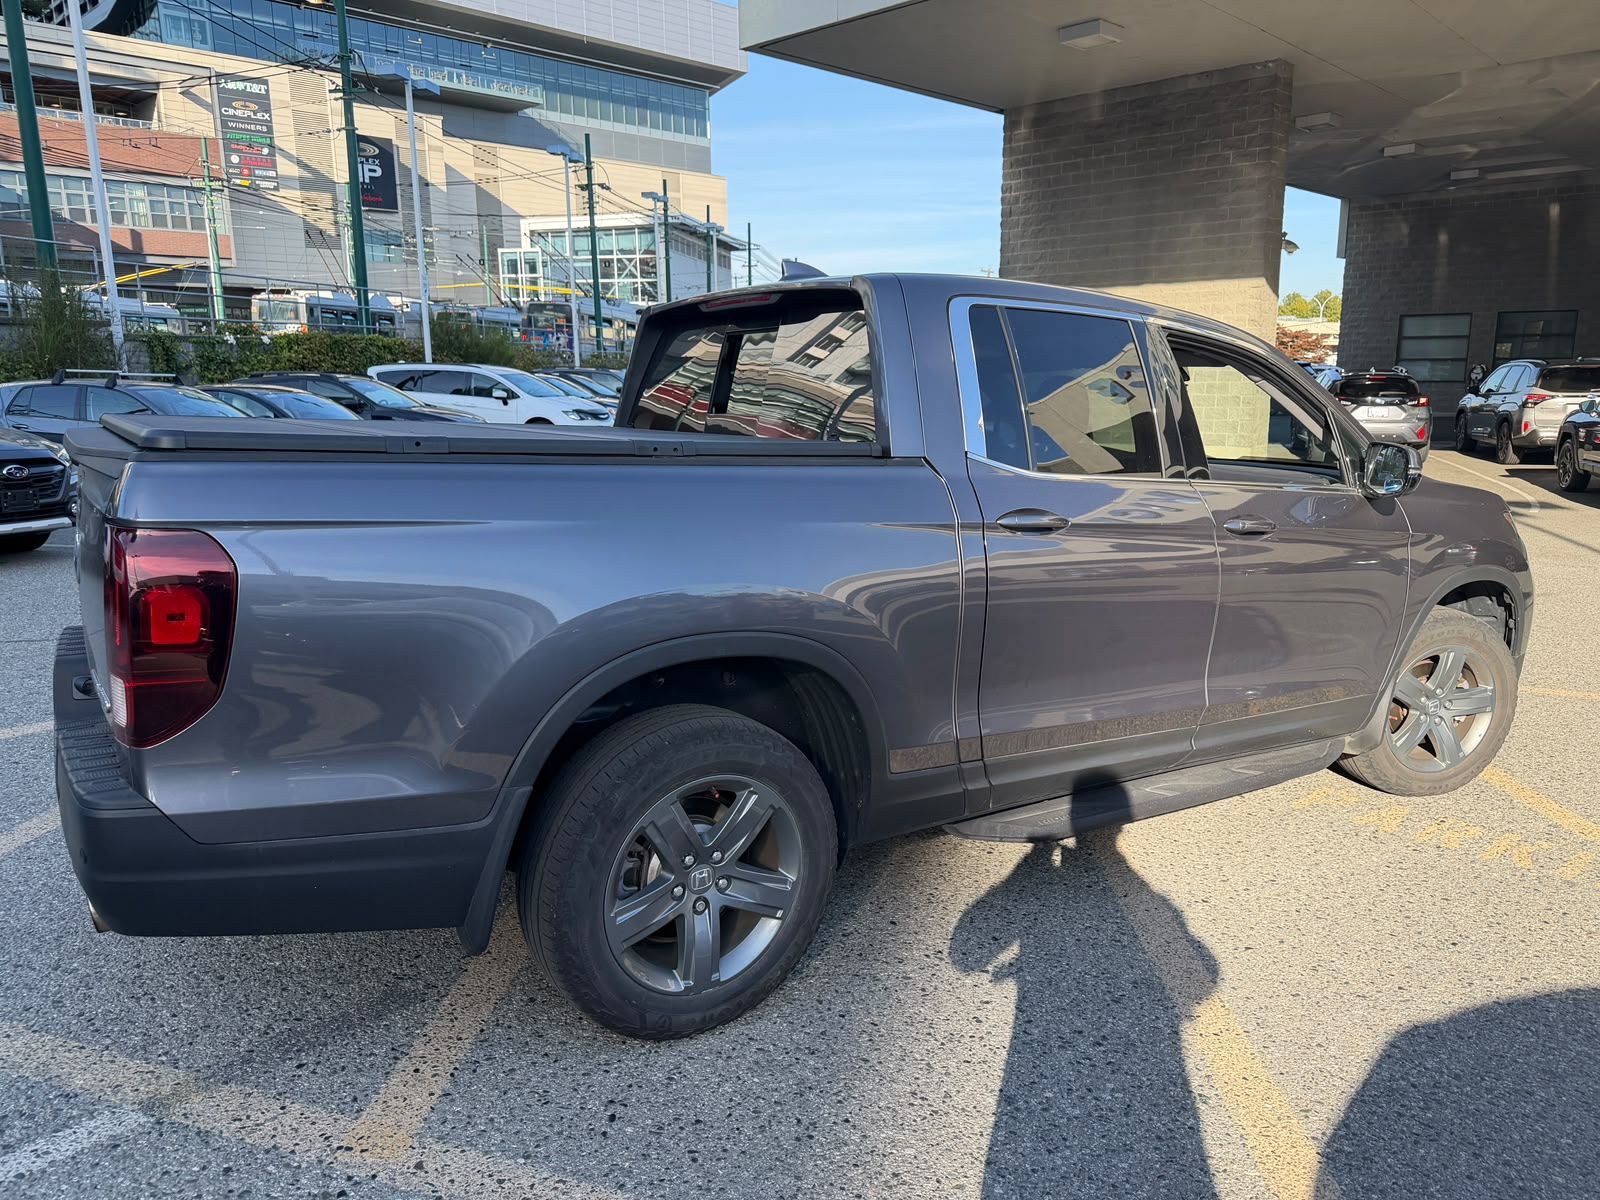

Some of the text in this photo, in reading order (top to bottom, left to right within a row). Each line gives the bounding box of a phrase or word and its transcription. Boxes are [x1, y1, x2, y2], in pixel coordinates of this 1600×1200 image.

[244, 82, 268, 94] T&T
[221, 107, 270, 120] CINEPLEX
[227, 121, 268, 132] WINNERS
[358, 157, 381, 165] PLEX
[358, 164, 383, 183] IP
